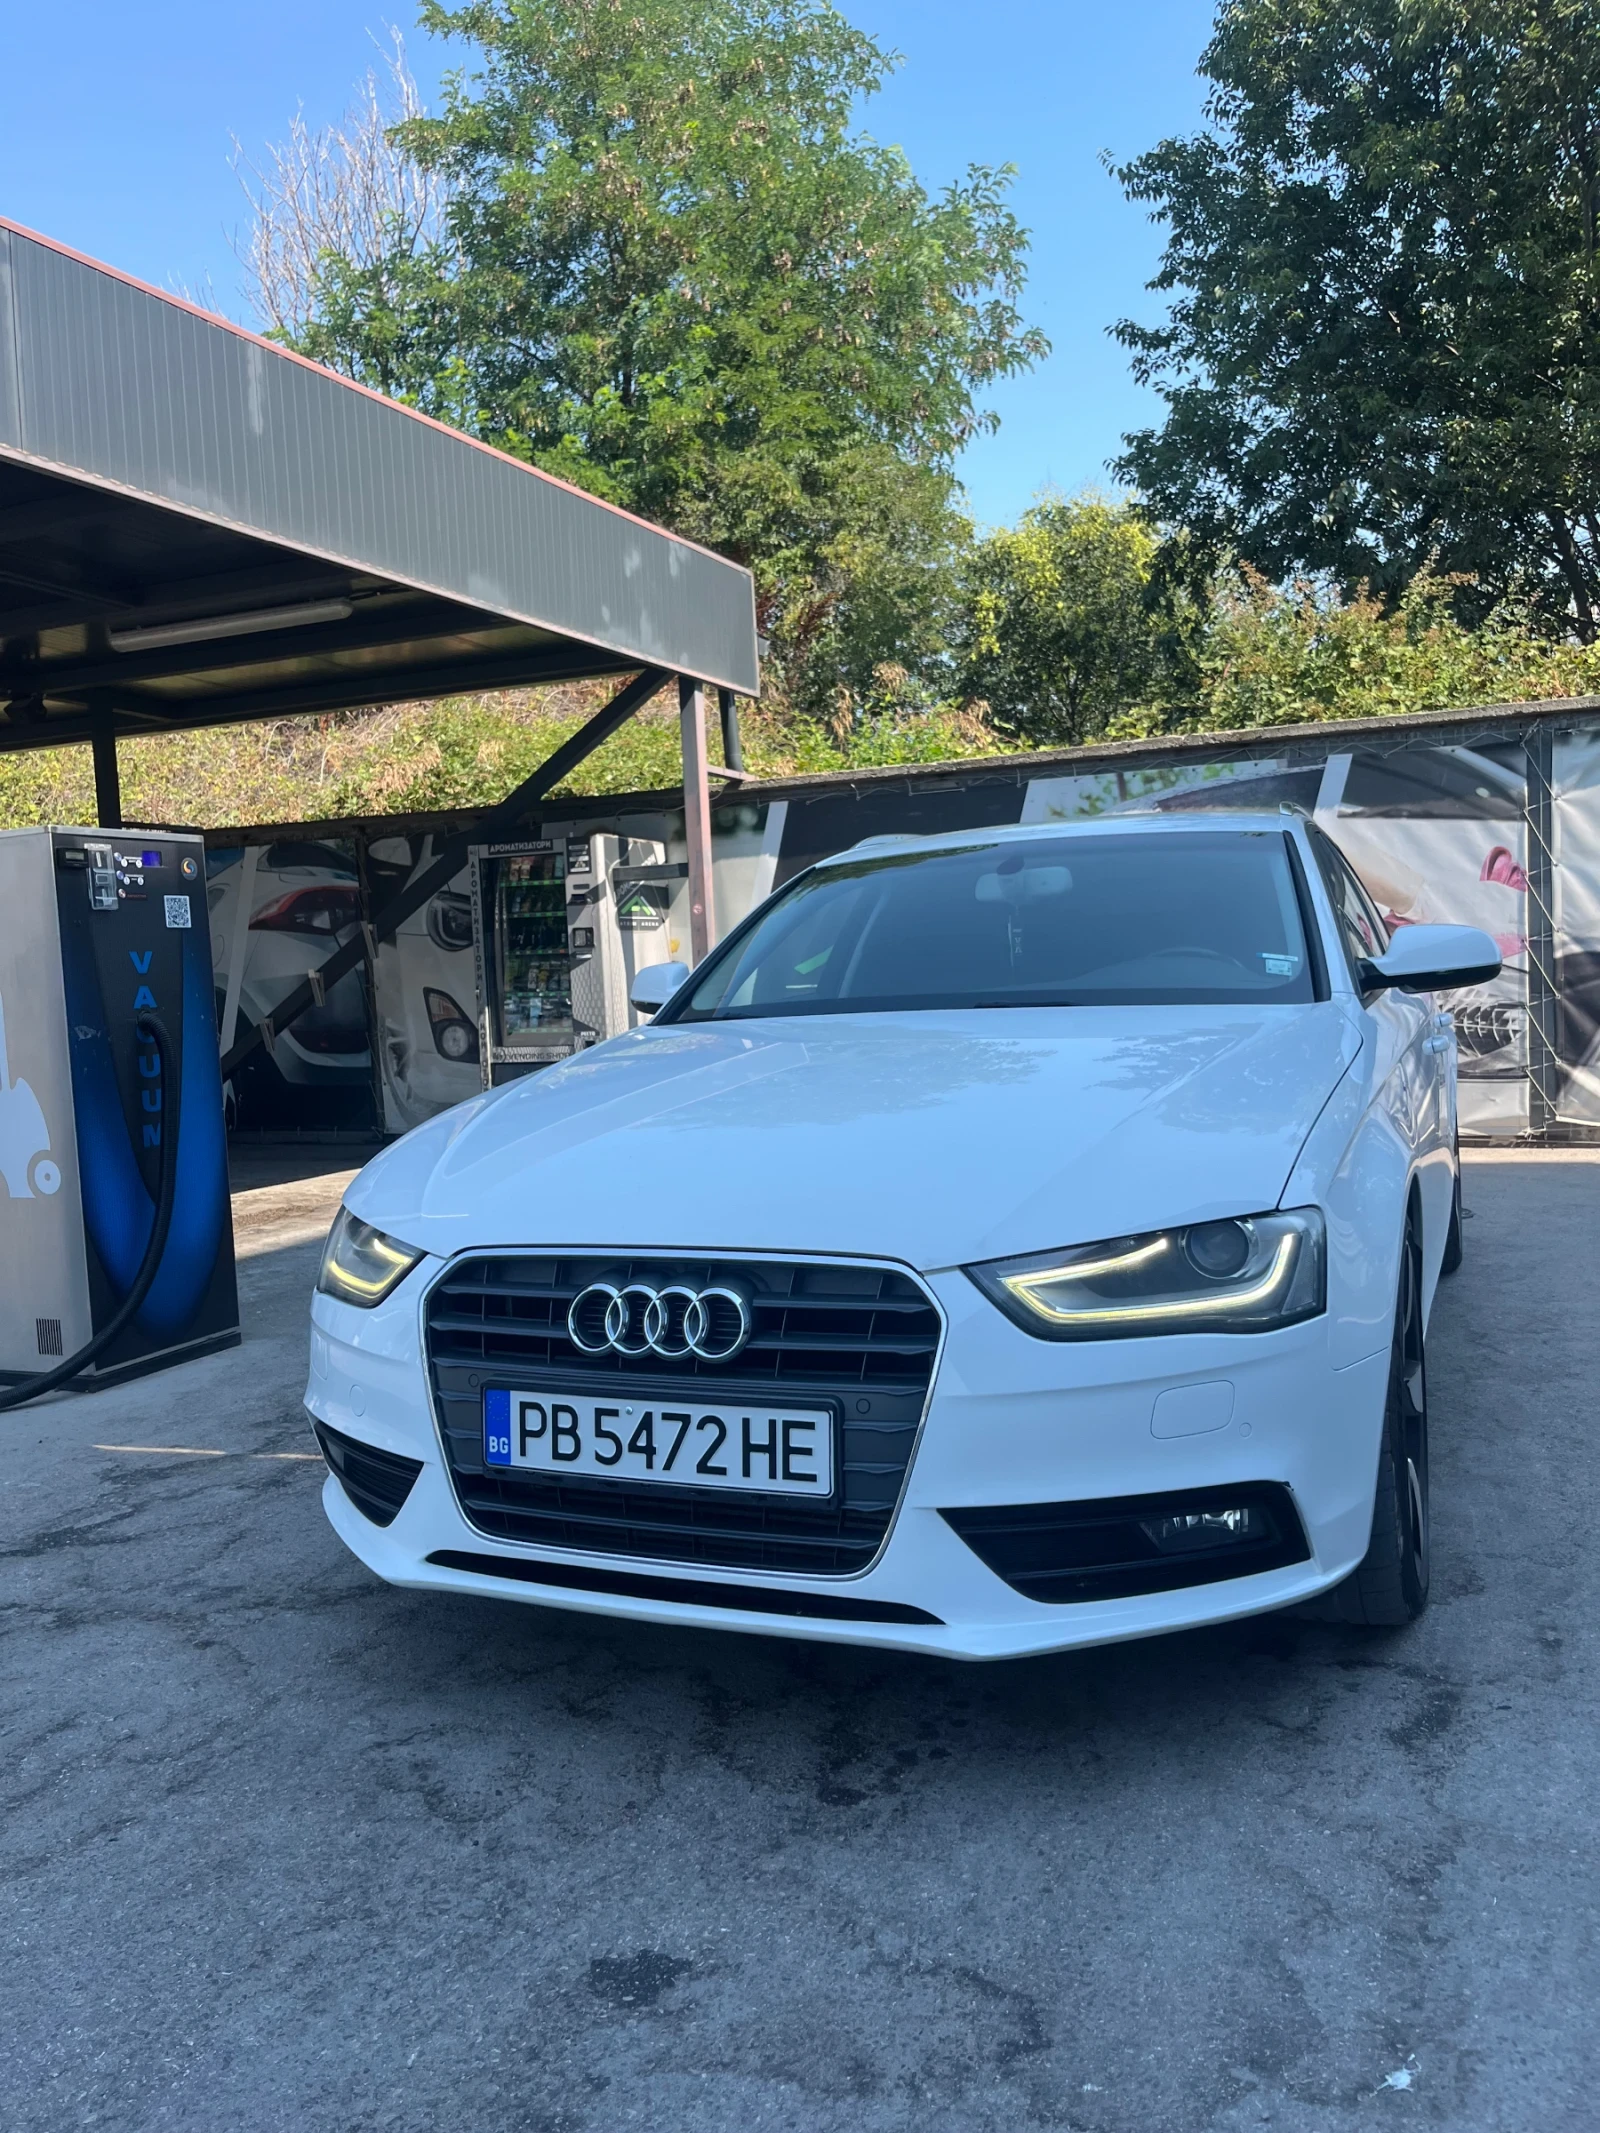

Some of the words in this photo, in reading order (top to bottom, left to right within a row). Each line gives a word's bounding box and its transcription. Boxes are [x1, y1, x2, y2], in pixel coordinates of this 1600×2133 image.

[490, 841, 551, 853] АРОМАТИЗАТОРИ
[489, 1436, 509, 1454] BG
[519, 1401, 581, 1460] PB
[594, 1407, 727, 1476] 5472
[742, 1417, 817, 1482] HE
